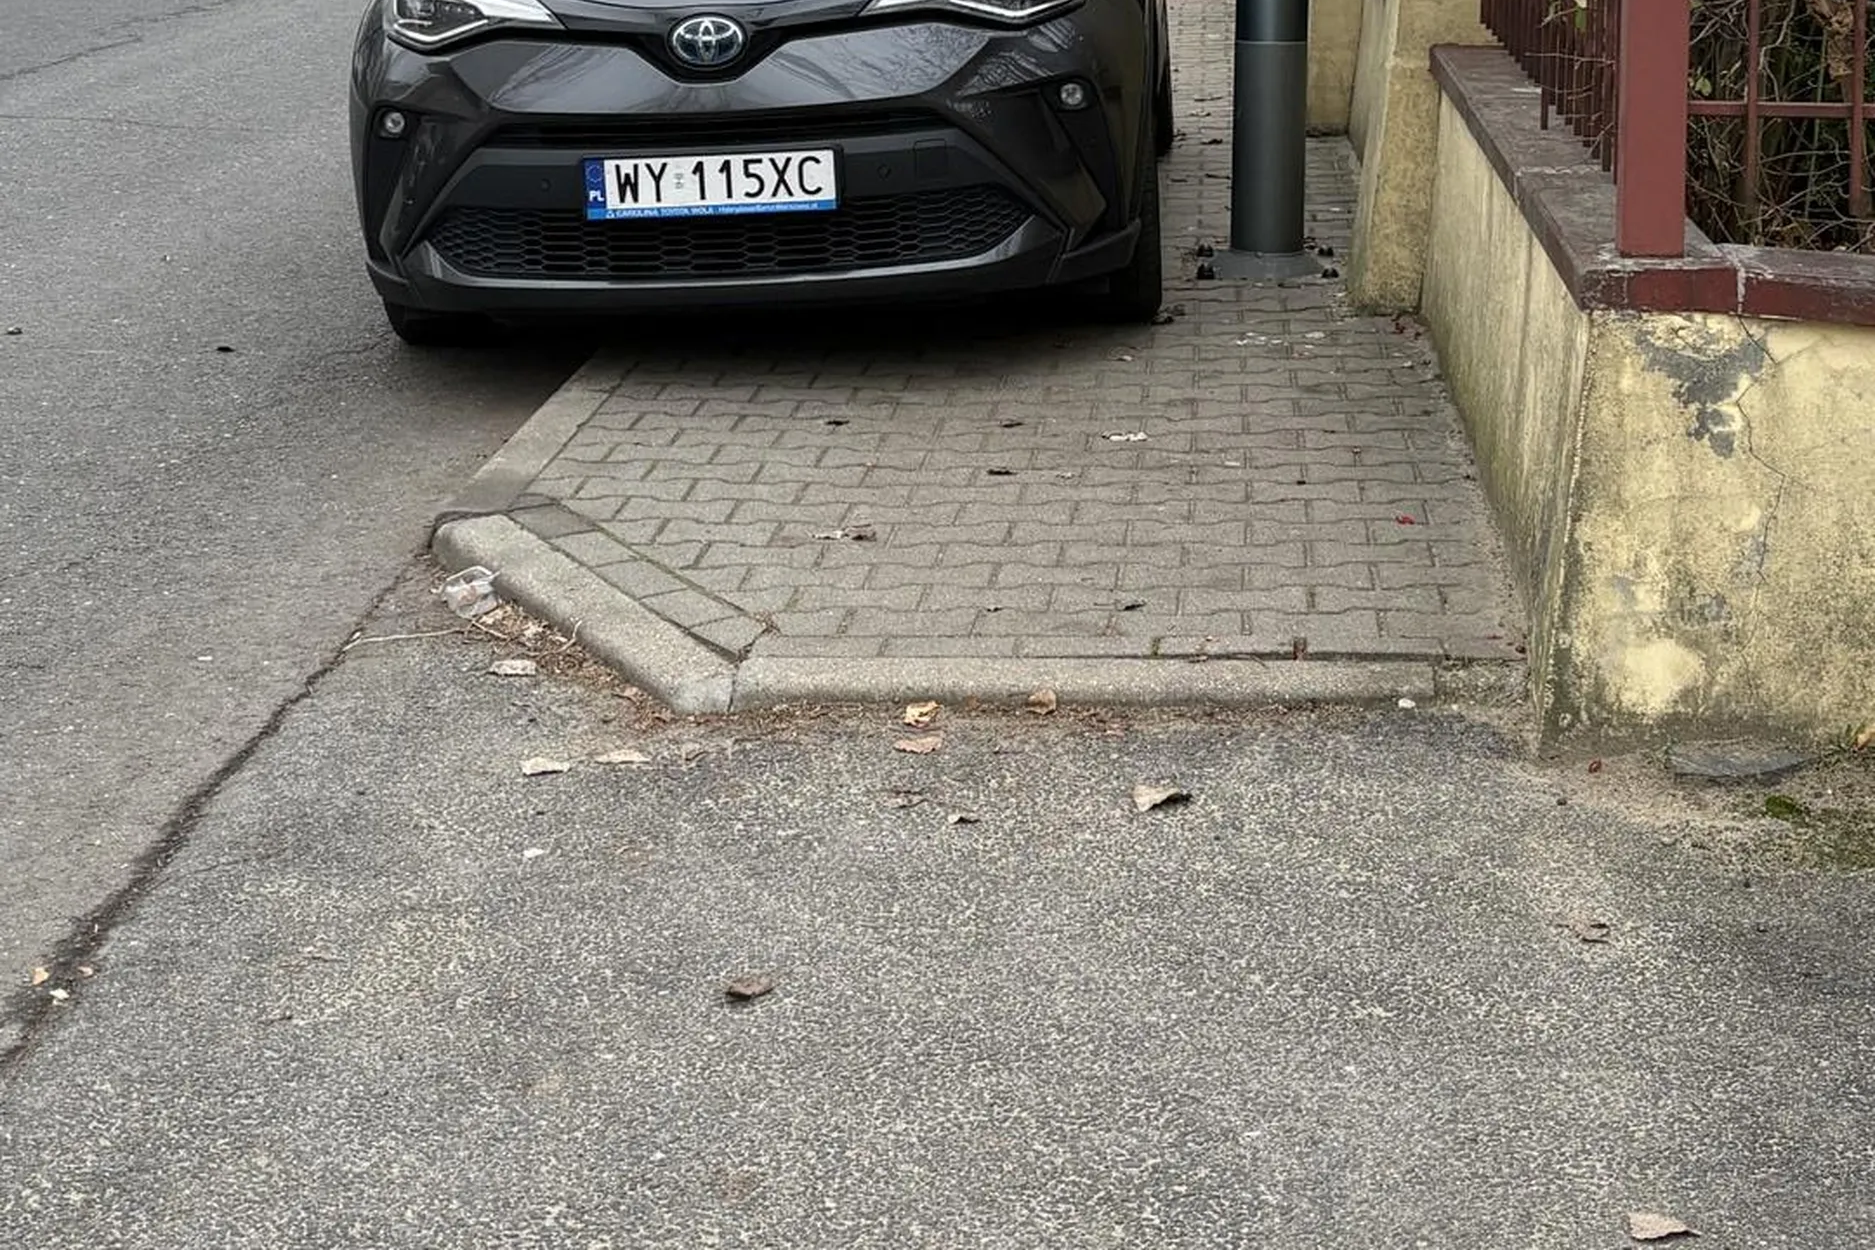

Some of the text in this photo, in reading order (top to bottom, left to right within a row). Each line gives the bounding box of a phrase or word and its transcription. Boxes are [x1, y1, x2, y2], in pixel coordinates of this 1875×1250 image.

[615, 155, 823, 204] WY 115XC
[588, 190, 605, 202] PL
